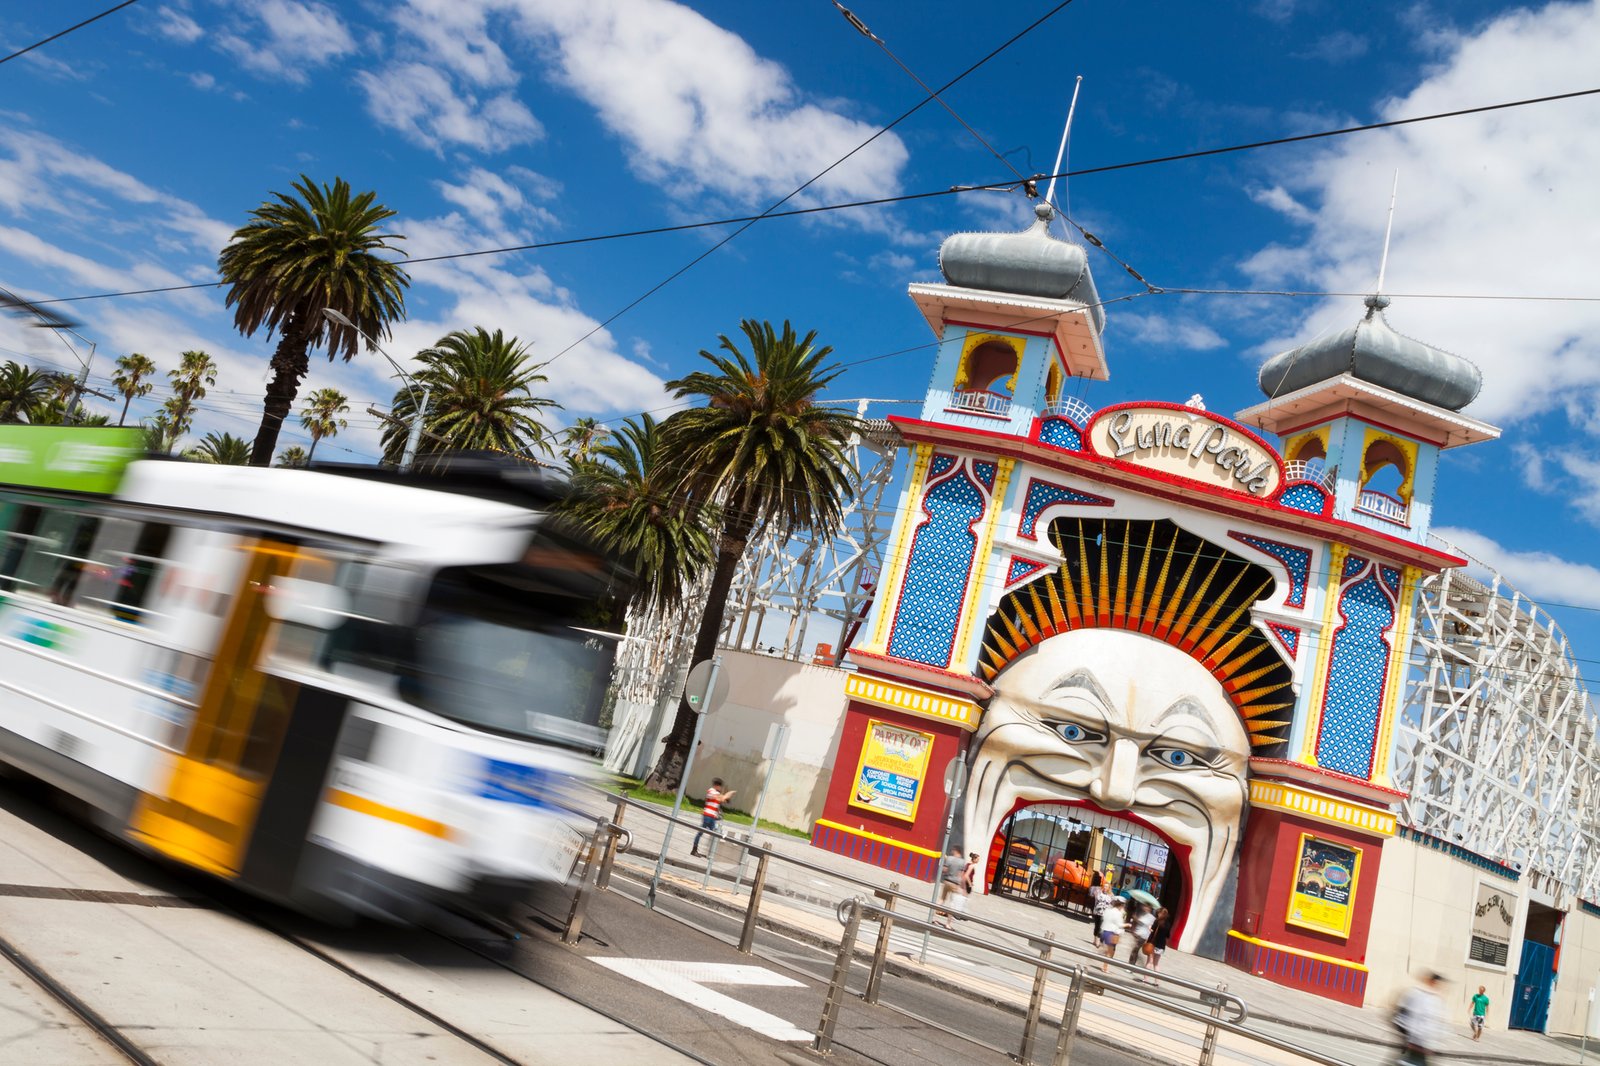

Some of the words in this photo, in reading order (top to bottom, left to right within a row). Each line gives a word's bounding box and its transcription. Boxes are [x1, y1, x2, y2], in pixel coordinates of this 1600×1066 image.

[1109, 411, 1192, 457] Luna
[1191, 424, 1272, 493] Park
[874, 728, 909, 747] PARTY
[867, 768, 890, 779] CORPORATE
[867, 773, 889, 782] FUNCTIONS
[896, 775, 915, 784] BIRTHDAY
[896, 780, 912, 788] PARTIES
[881, 781, 897, 789] SCHOOL
[897, 785, 914, 794] GROUPS
[882, 788, 897, 796] SPECIAL
